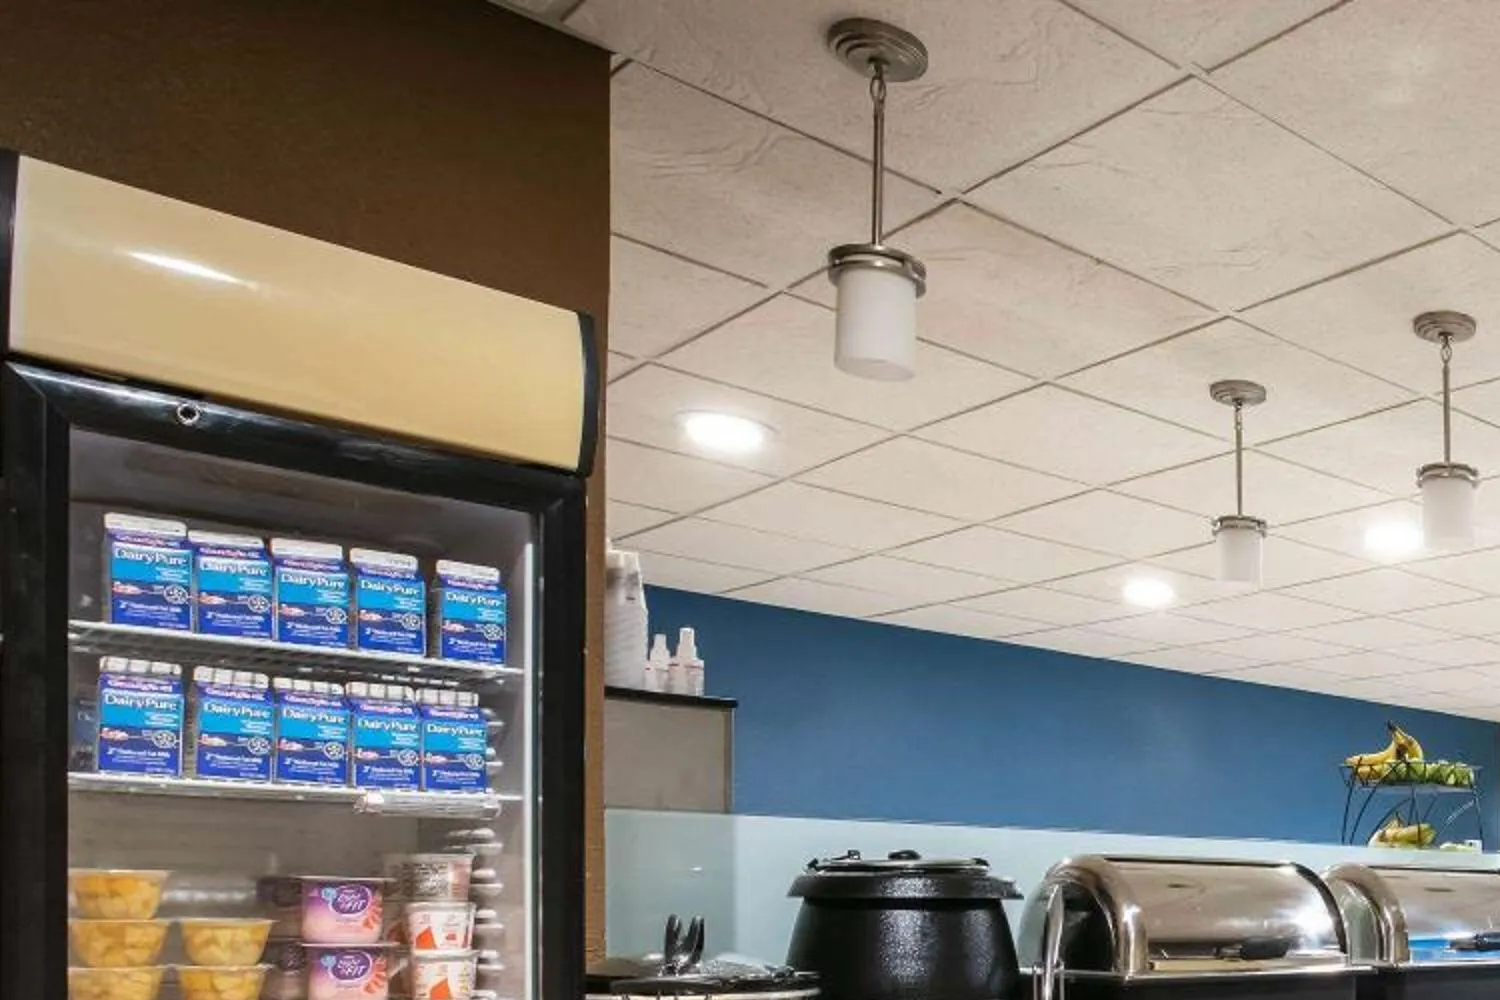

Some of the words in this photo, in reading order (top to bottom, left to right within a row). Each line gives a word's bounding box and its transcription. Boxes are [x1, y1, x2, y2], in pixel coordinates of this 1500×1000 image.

[113, 548, 188, 566] DairyPure
[200, 560, 268, 577] DairyPure
[281, 573, 345, 589] DairyPure
[360, 578, 420, 596] DairyPure
[446, 591, 501, 606] DairyPure
[104, 692, 177, 711] DairyPure
[203, 701, 271, 718] DairyPure
[282, 707, 345, 724] DairyPure
[357, 718, 418, 732] DairyPure
[427, 723, 484, 737] DairyPure
